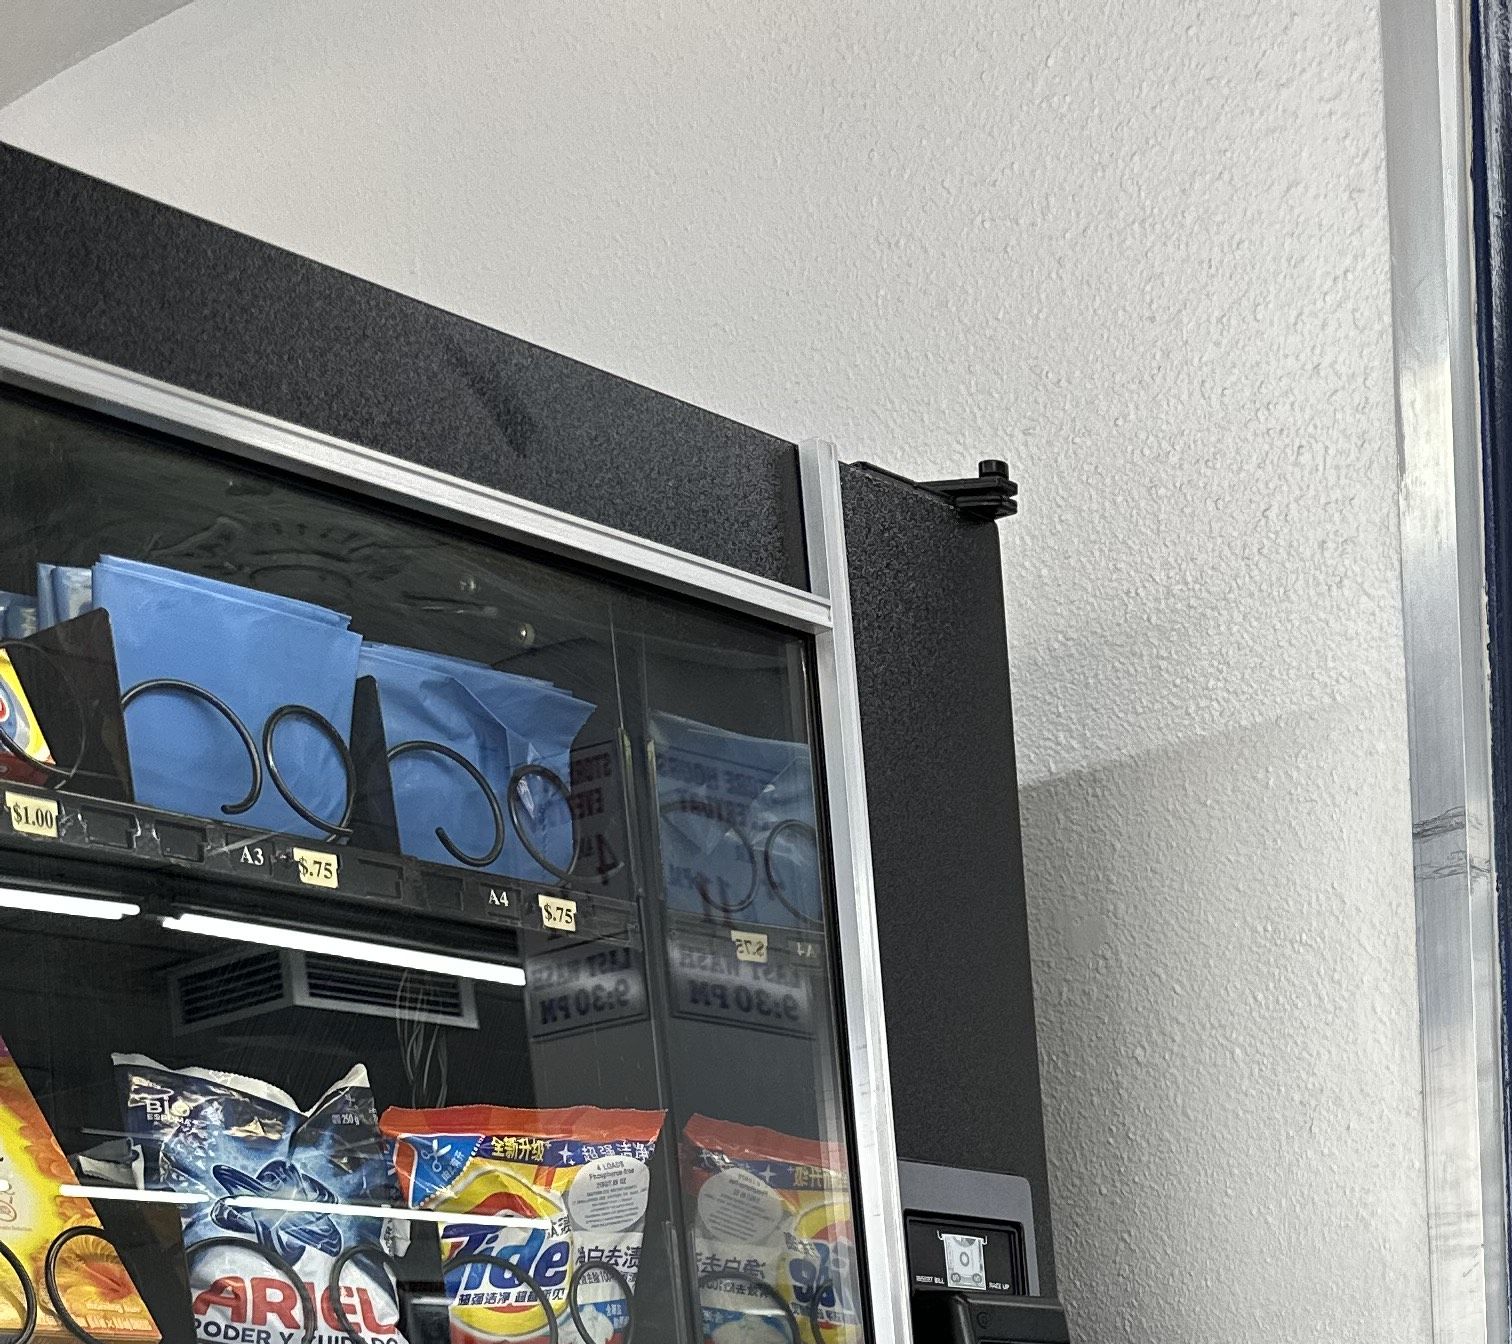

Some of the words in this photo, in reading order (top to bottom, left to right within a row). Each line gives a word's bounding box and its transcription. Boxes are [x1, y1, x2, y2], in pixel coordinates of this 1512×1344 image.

[13, 801, 54, 829] $1.00
[239, 845, 265, 867] A3
[298, 856, 333, 880] $.75
[488, 888, 510, 909] A4
[543, 903, 574, 924] $.75
[441, 1221, 571, 1291] Tide
[193, 1275, 398, 1335] ARIEL
